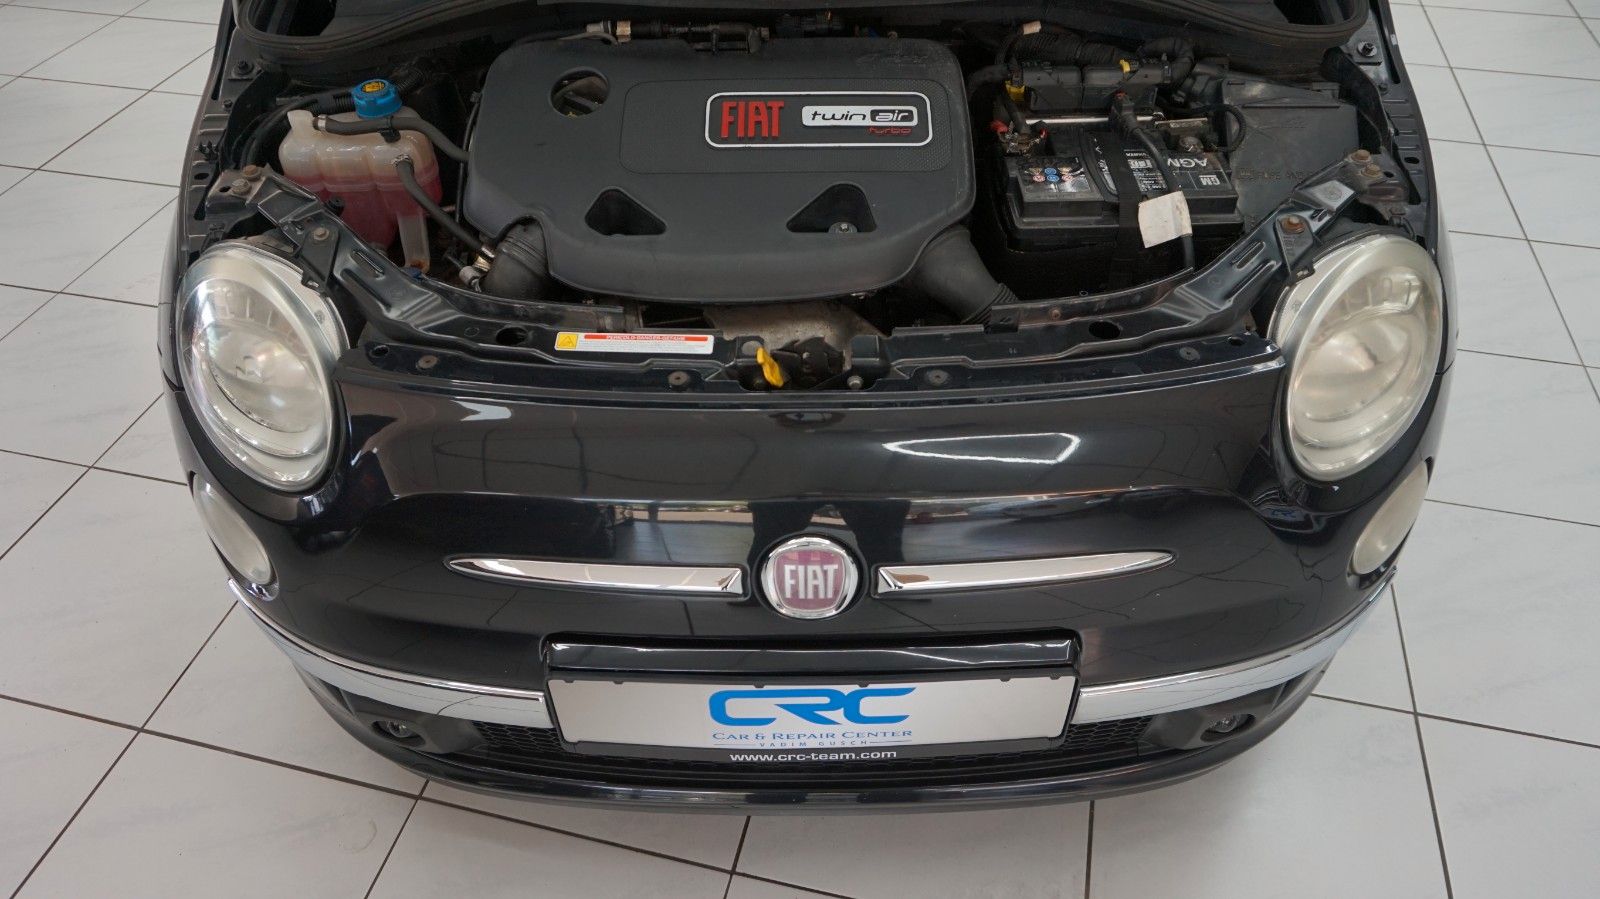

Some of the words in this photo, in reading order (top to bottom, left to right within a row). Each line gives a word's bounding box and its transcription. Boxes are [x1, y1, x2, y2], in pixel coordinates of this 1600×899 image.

[720, 100, 785, 139] FIAT
[811, 110, 866, 121] twin
[876, 110, 909, 121] air
[867, 126, 912, 135] turbo
[784, 564, 838, 600] FIAT
[708, 687, 917, 727] CRC
[712, 732, 749, 740] CAR
[755, 732, 765, 740] &
[772, 731, 836, 740] REPAIR
[842, 730, 913, 739] CENTER
[729, 750, 897, 762] www.crc-team.com
